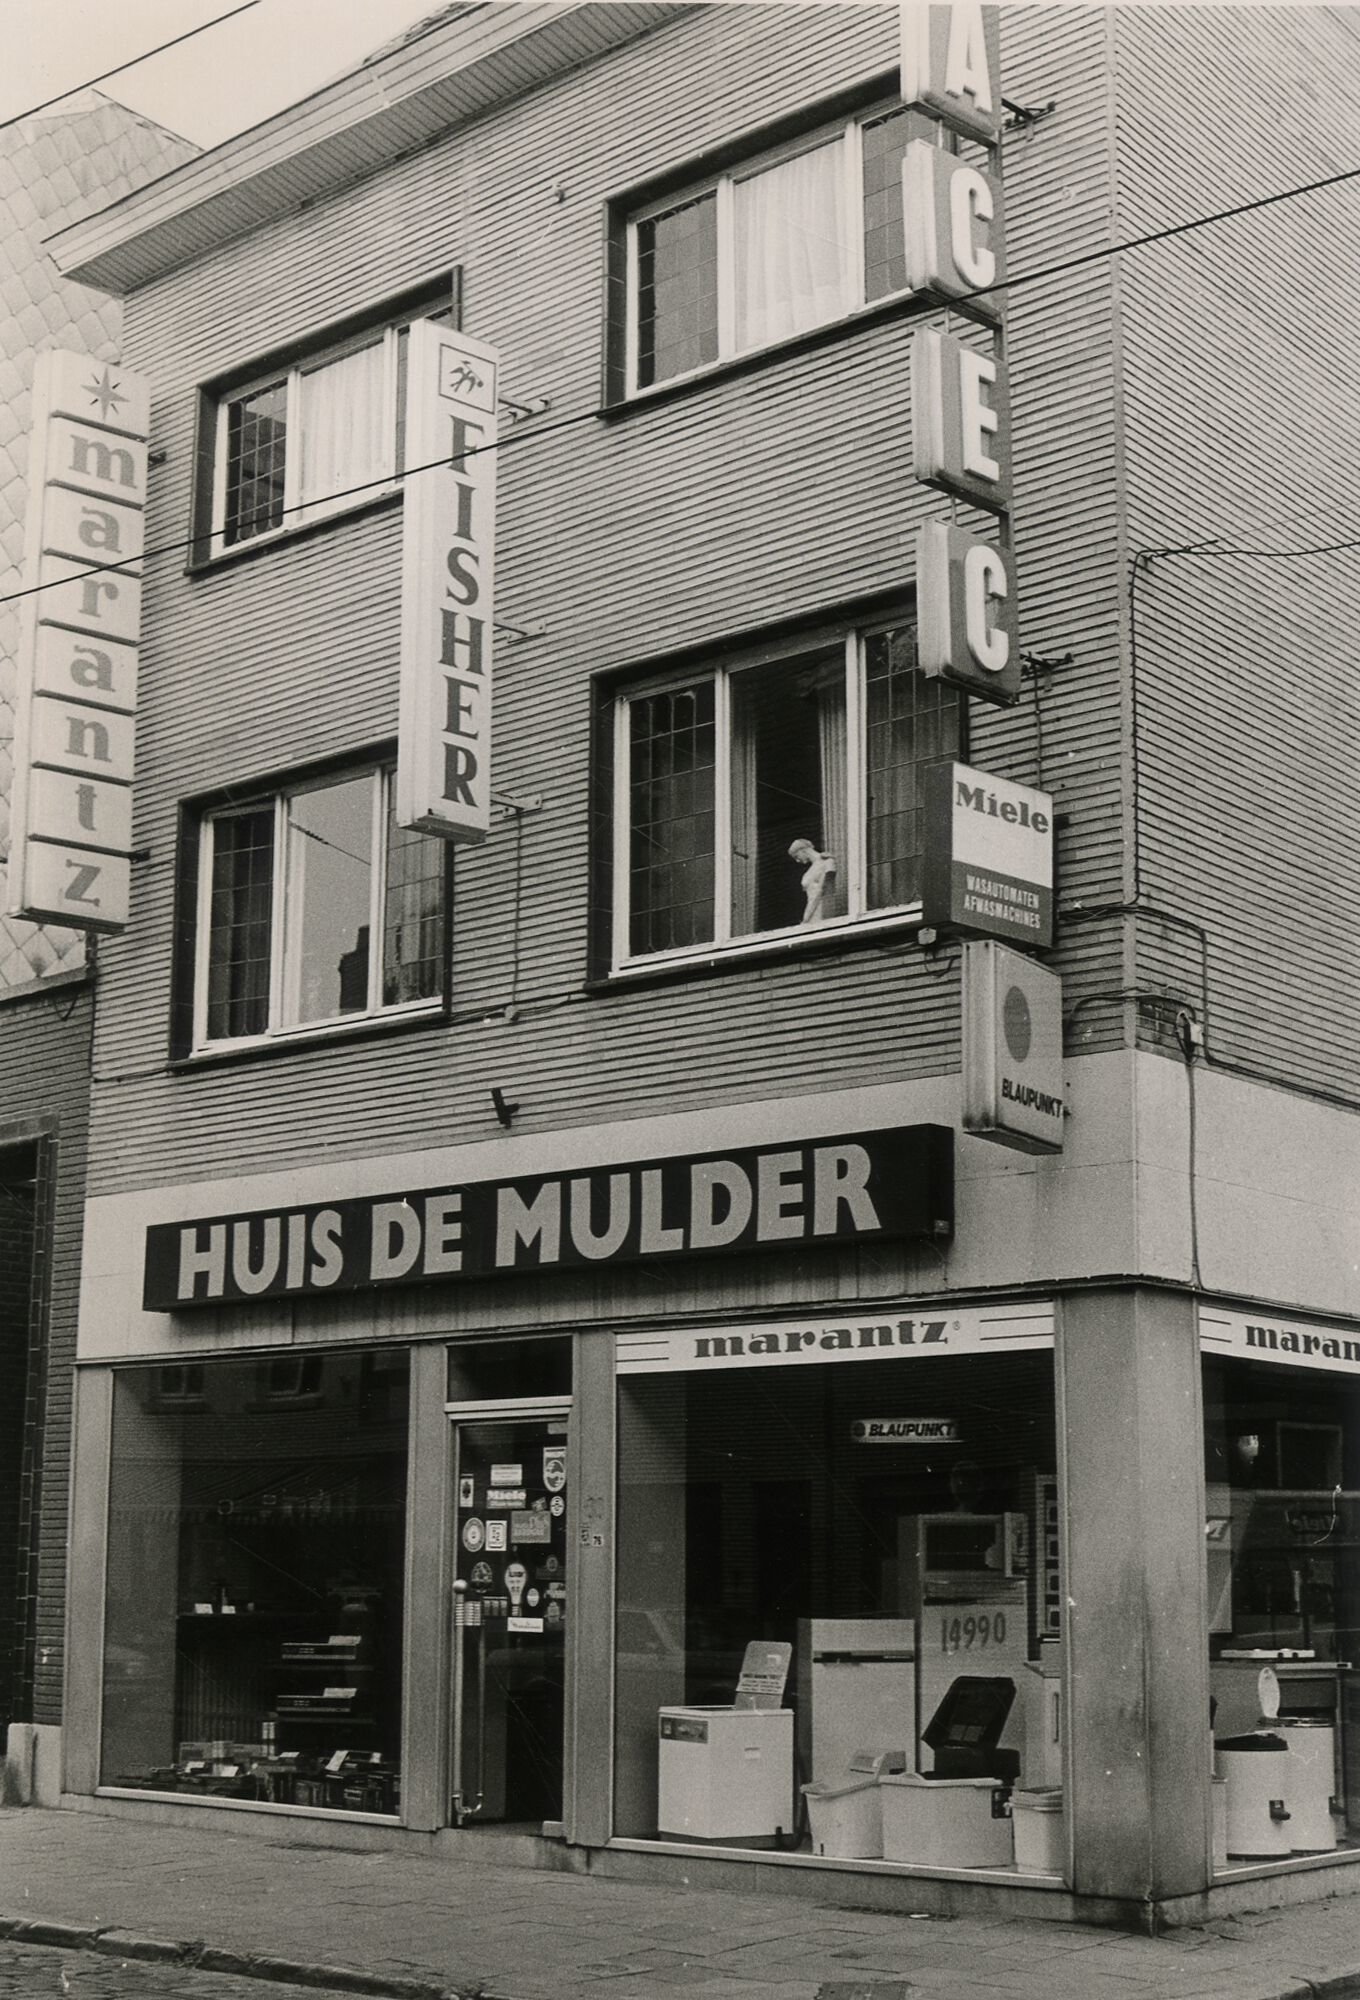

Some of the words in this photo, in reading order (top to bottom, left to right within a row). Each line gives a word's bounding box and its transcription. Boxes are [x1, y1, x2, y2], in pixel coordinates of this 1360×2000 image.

[438, 415, 486, 808] FISHER
[64, 433, 137, 907] marantz
[955, 780, 1049, 834] Miele
[1002, 1078, 1063, 1118] BLAUPUNKT
[176, 1208, 344, 1301] HUIS
[369, 1192, 463, 1282] DE
[494, 1143, 882, 1268] MULDER
[694, 1319, 949, 1358] marantz
[869, 1422, 954, 1437] BLAUPUNKT
[941, 1611, 1006, 1652] 14990
